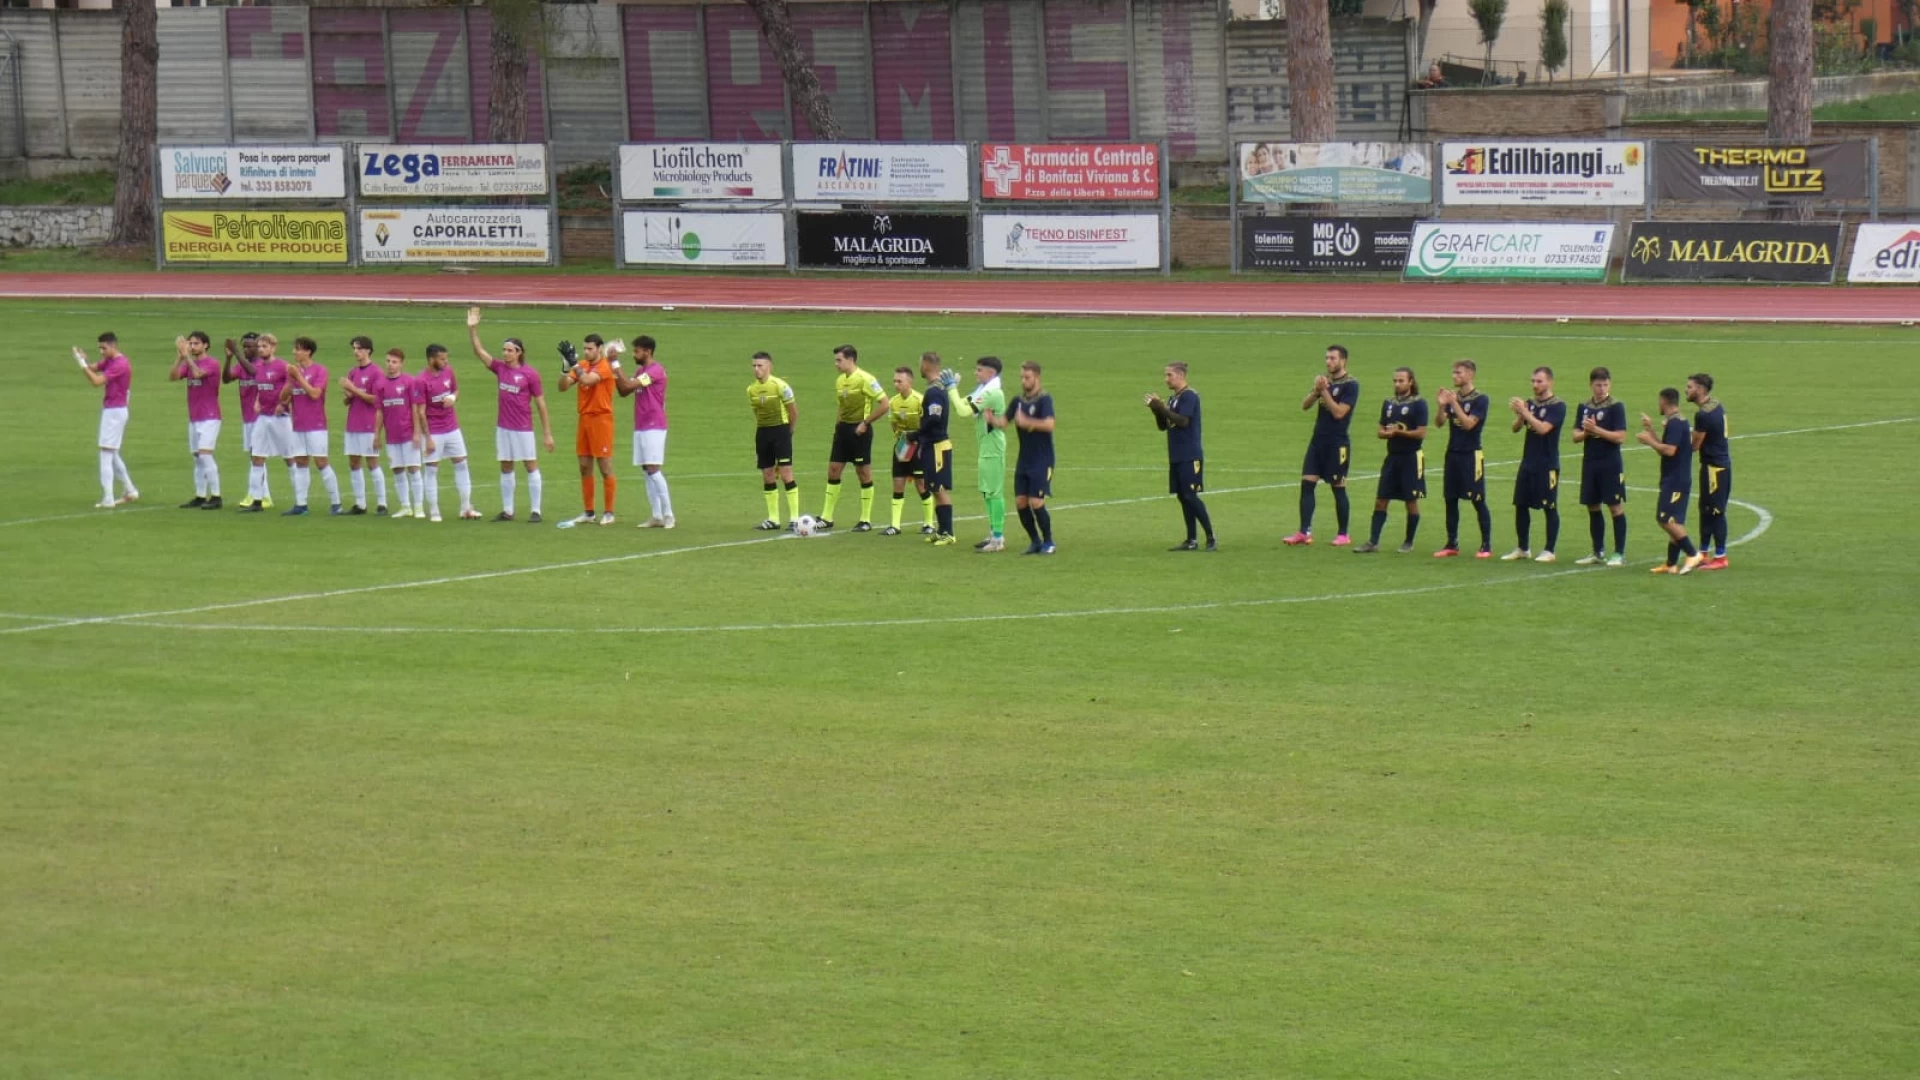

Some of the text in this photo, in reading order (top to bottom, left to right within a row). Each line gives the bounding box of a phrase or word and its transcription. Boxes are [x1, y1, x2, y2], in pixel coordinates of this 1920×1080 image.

[174, 151, 227, 174] Salvucci
[239, 152, 330, 165] Posa in opera parquet
[441, 155, 515, 167] FERRAMENTA
[1024, 146, 1154, 166] Farmacia Centrale
[1693, 148, 1807, 165] THERMO
[364, 152, 440, 183] Zega
[818, 150, 880, 180] FRATINI
[1489, 148, 1625, 178] Edilbiangi s.r.l.
[240, 166, 316, 178] Rifiniture di interni
[652, 171, 752, 186] Microbiology Products
[1025, 168, 1155, 183] di Bonifazi Viviana & C.
[1764, 164, 1824, 192] LUTZ
[256, 181, 271, 191] 333
[817, 181, 878, 190] ASCENSORI
[1299, 176, 1333, 184] MEDICO
[441, 184, 473, 194] Tolentino
[1050, 188, 1070, 197] della
[1074, 188, 1105, 197] Libertà
[1114, 188, 1154, 197] Tolentino
[426, 213, 522, 225] Autocarrozzeria
[213, 214, 343, 240] Petroltenna
[413, 225, 523, 239] CAPORALETTI
[1025, 228, 1128, 240] TEKNO DISINFEST
[1254, 233, 1294, 244] tolentino
[169, 242, 343, 254] ENERGIA CHE PRODUCE
[834, 237, 934, 253] MALAGRIDA
[1432, 233, 1543, 252] GRAFICART
[1559, 244, 1604, 253] TOLENTINO
[365, 250, 403, 259] RENAULT
[1668, 238, 1832, 265] MALAGRIDA
[1875, 241, 1920, 268] edi
[878, 255, 884, 264] &
[885, 256, 926, 266] sportswear
[1460, 254, 1537, 264] tipografia
